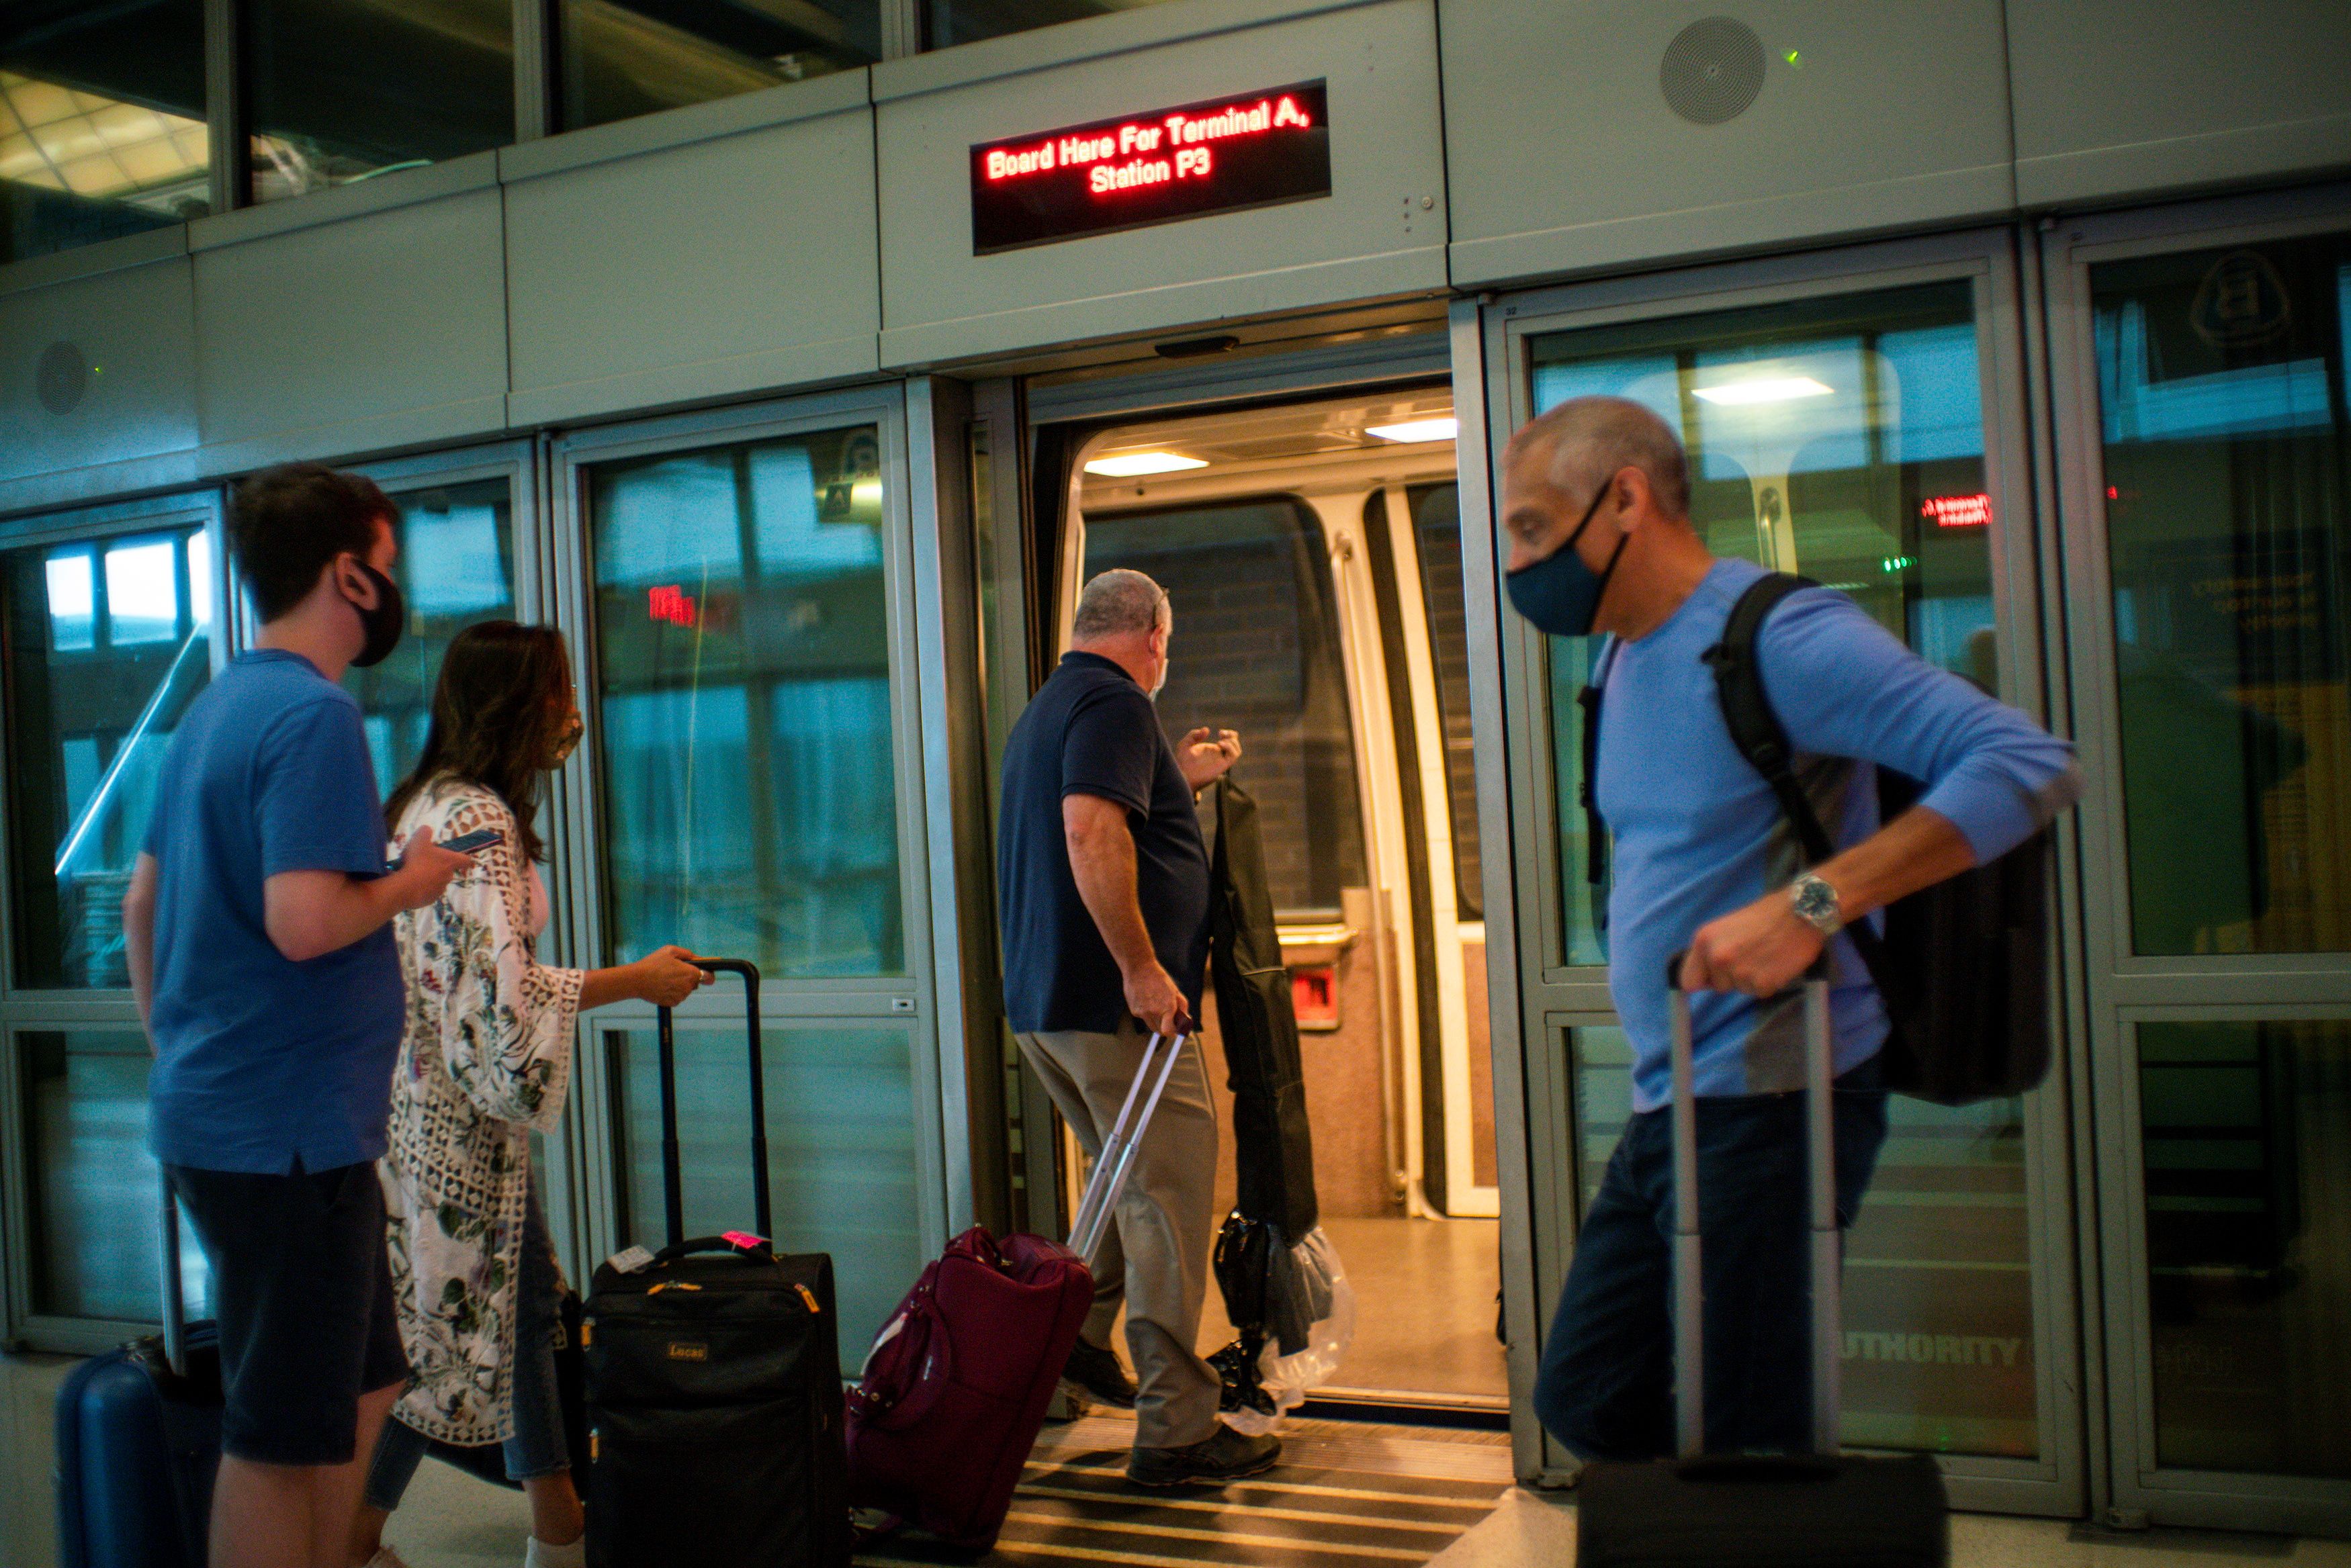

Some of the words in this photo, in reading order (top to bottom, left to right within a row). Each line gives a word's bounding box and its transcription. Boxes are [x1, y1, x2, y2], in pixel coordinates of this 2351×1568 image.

[987, 142, 1055, 179] Board
[1059, 136, 1116, 166] Here
[1119, 125, 1162, 154] For
[1165, 101, 1271, 145] Terminal
[1273, 97, 1310, 128] A,
[1090, 158, 1171, 193] Station
[1175, 146, 1212, 178] P3
[1837, 1330, 2023, 1366] UTHORITY
